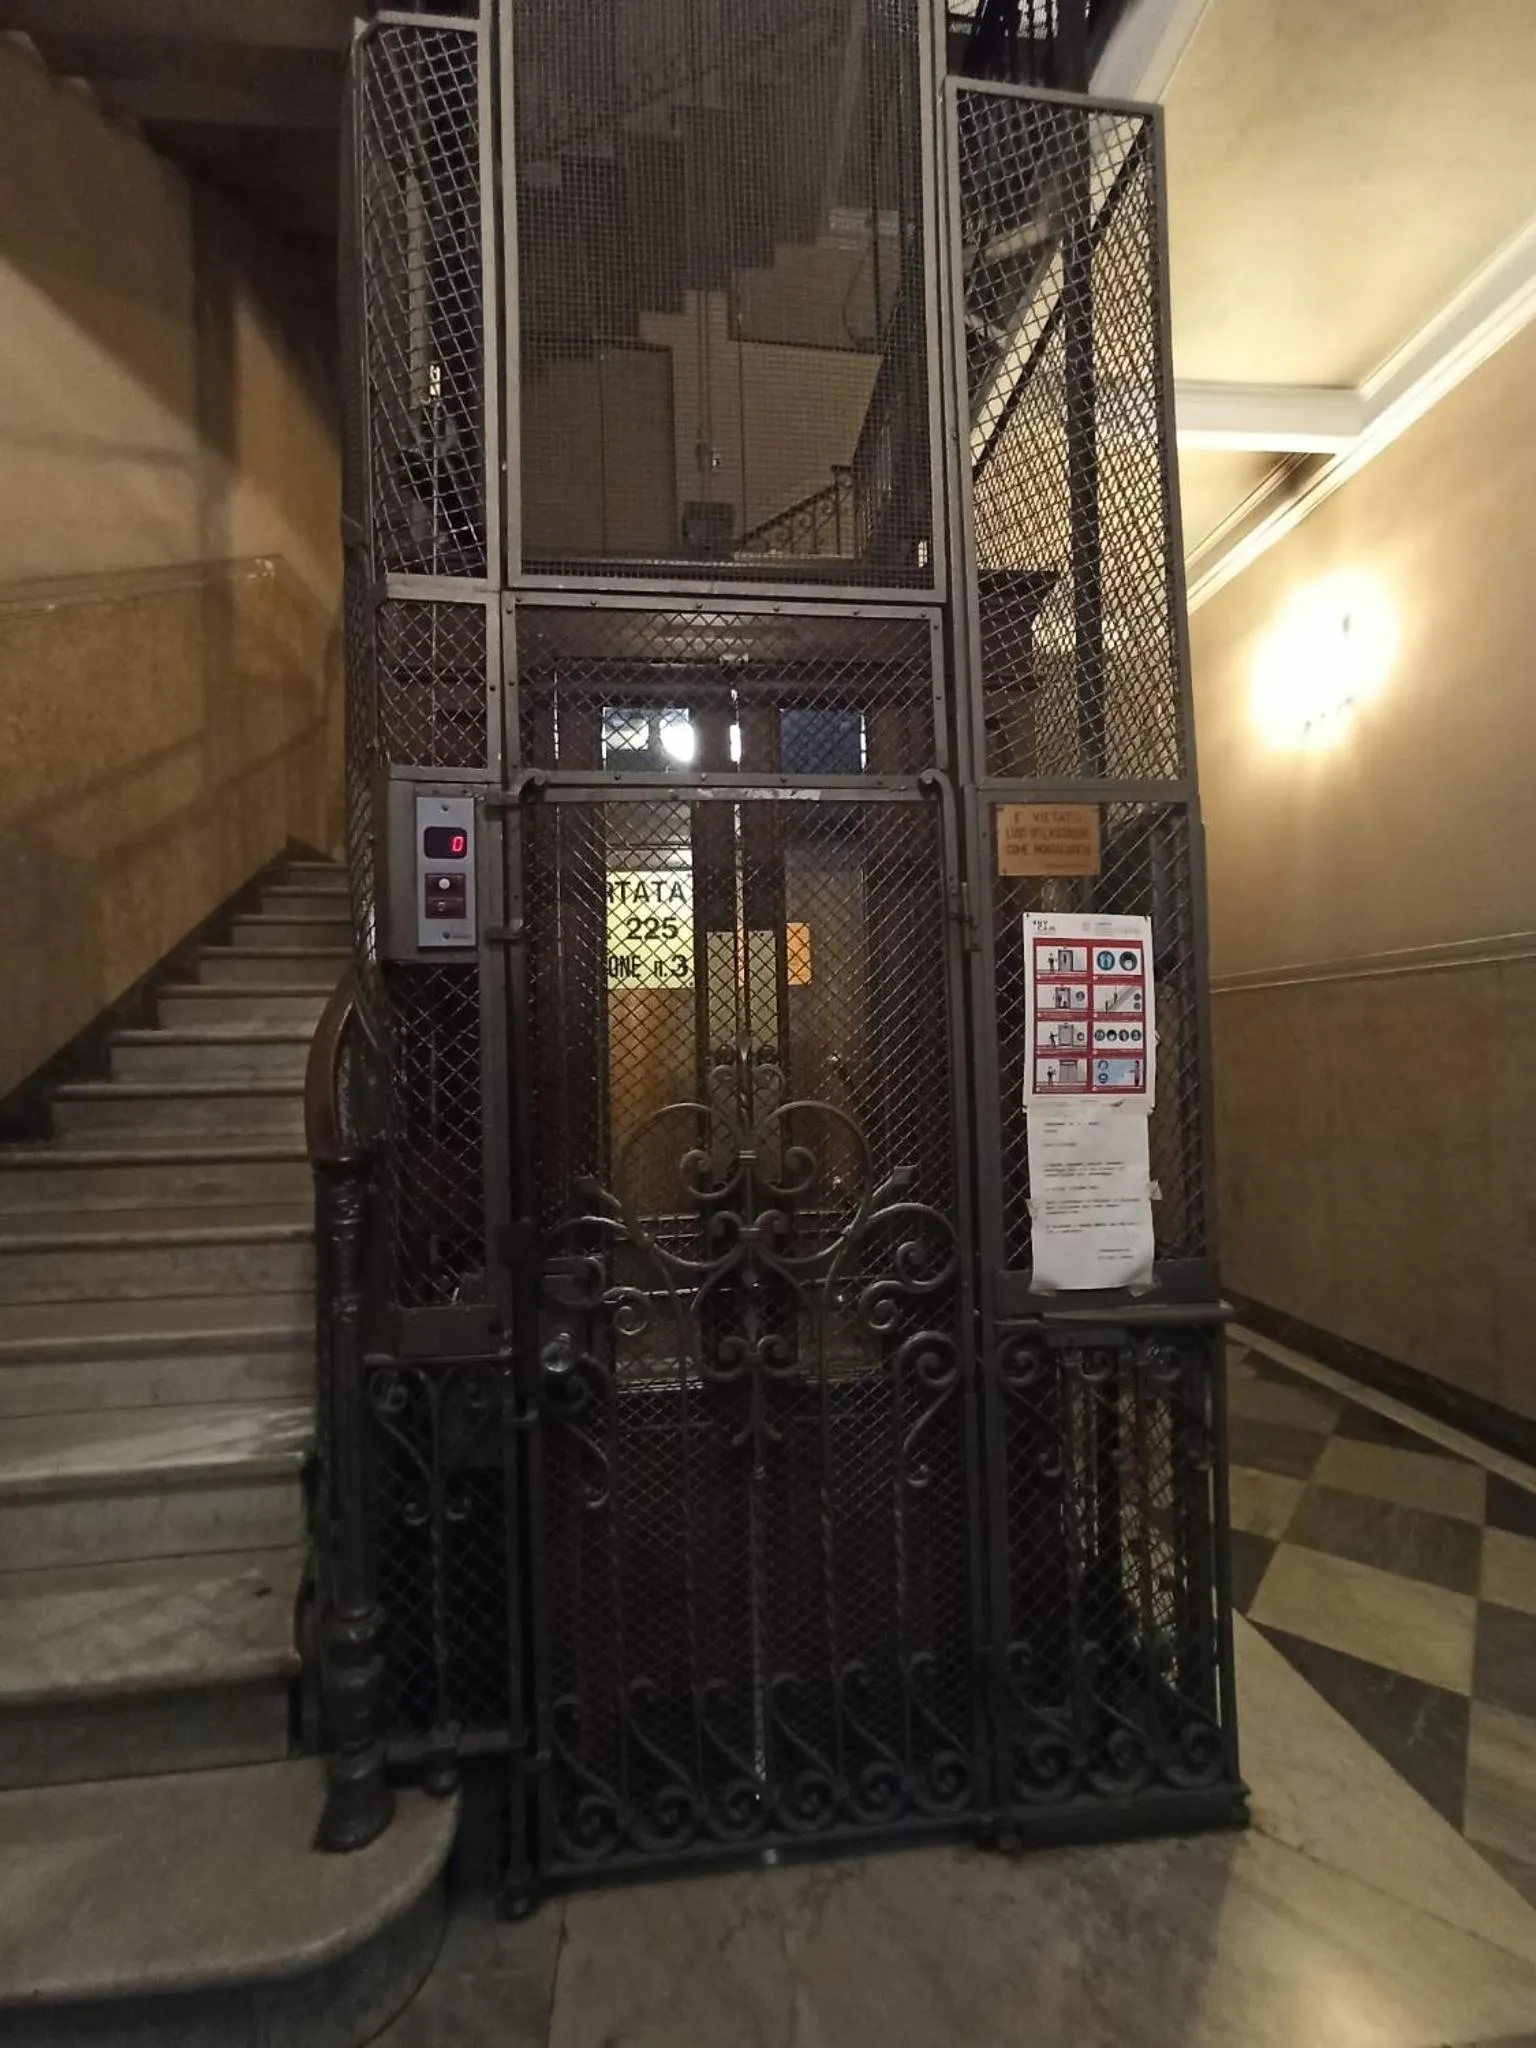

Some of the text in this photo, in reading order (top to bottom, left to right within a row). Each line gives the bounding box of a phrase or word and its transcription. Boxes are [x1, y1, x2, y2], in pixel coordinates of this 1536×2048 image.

[1033, 811, 1082, 823] VIETATO
[452, 836, 464, 852] 0
[626, 917, 679, 940] 225
